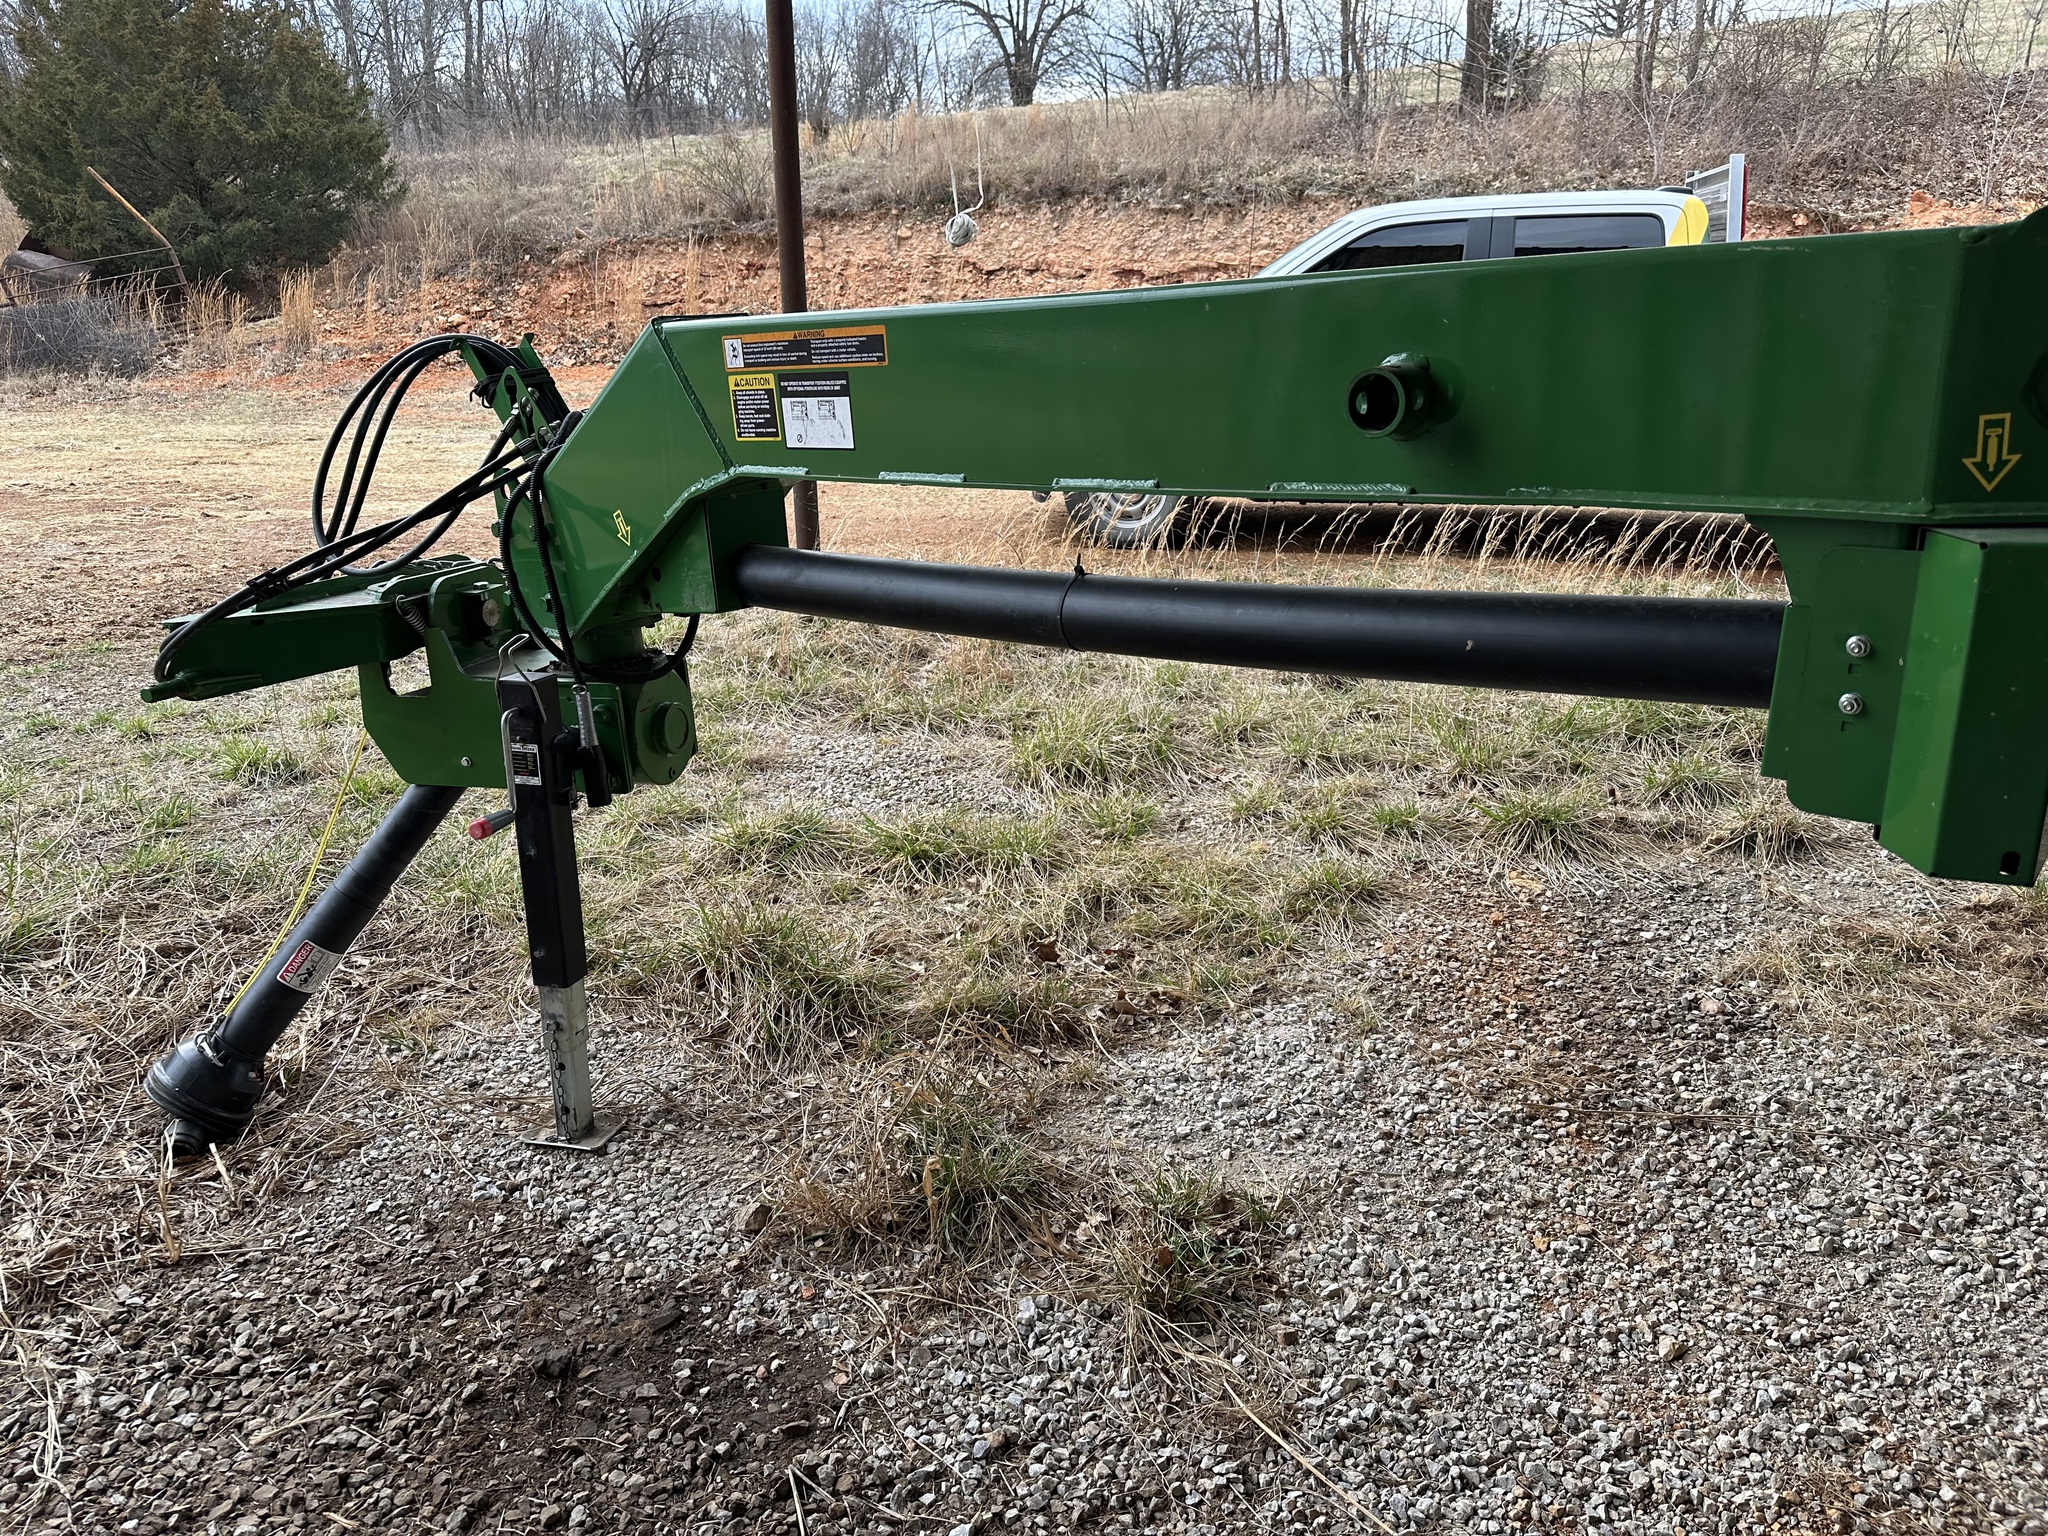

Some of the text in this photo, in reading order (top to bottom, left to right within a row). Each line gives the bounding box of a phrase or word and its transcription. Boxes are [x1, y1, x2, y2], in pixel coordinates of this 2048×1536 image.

[797, 330, 825, 339] WARNING
[740, 377, 770, 387] CAUTION
[288, 944, 314, 973] DANGER
